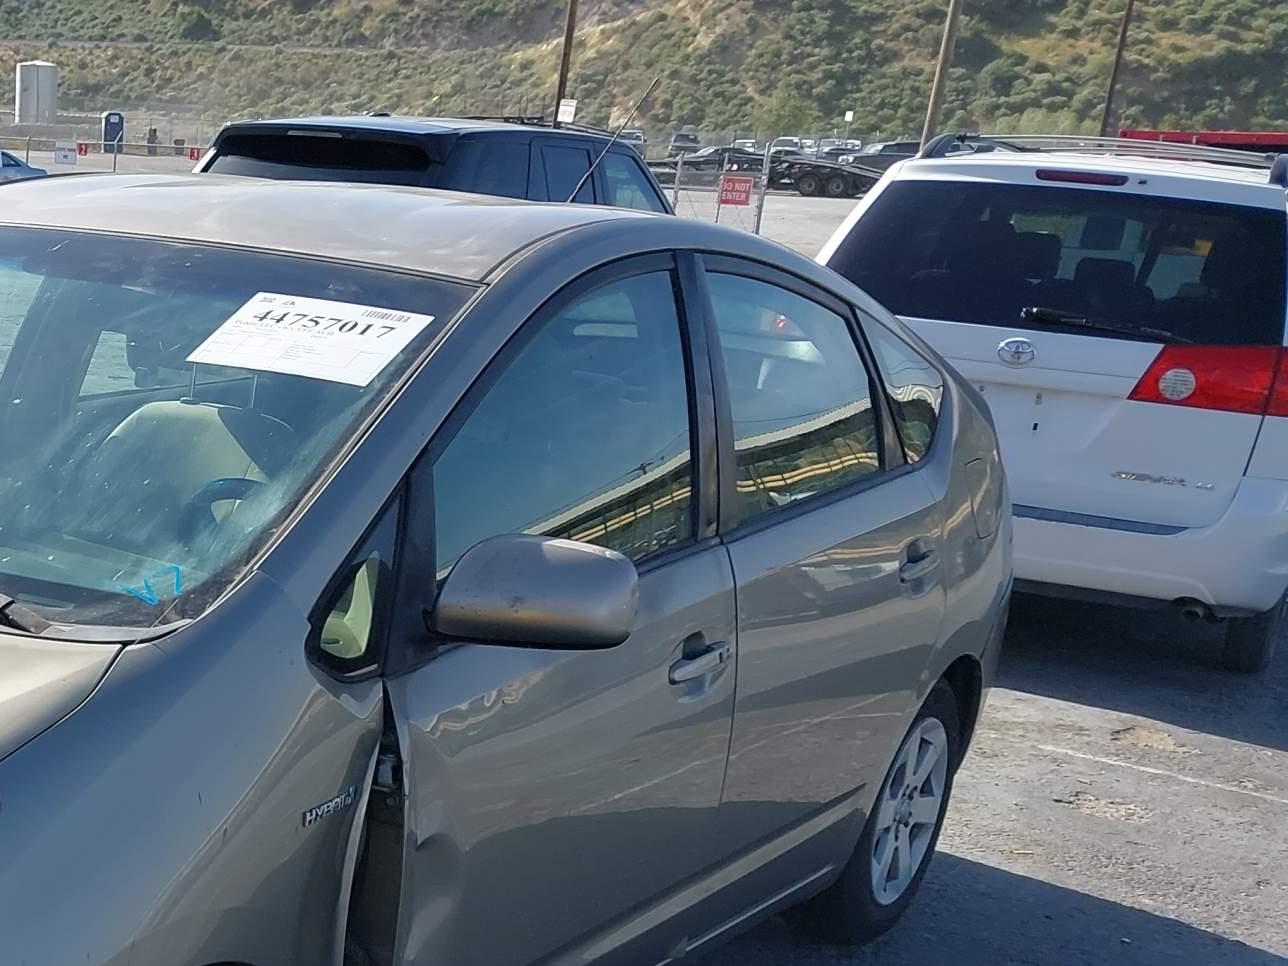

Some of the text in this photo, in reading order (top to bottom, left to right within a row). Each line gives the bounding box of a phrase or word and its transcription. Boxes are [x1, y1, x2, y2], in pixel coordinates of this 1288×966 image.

[734, 183, 750, 191] NOT
[722, 191, 746, 201] ENTER
[251, 309, 397, 339] 44757017
